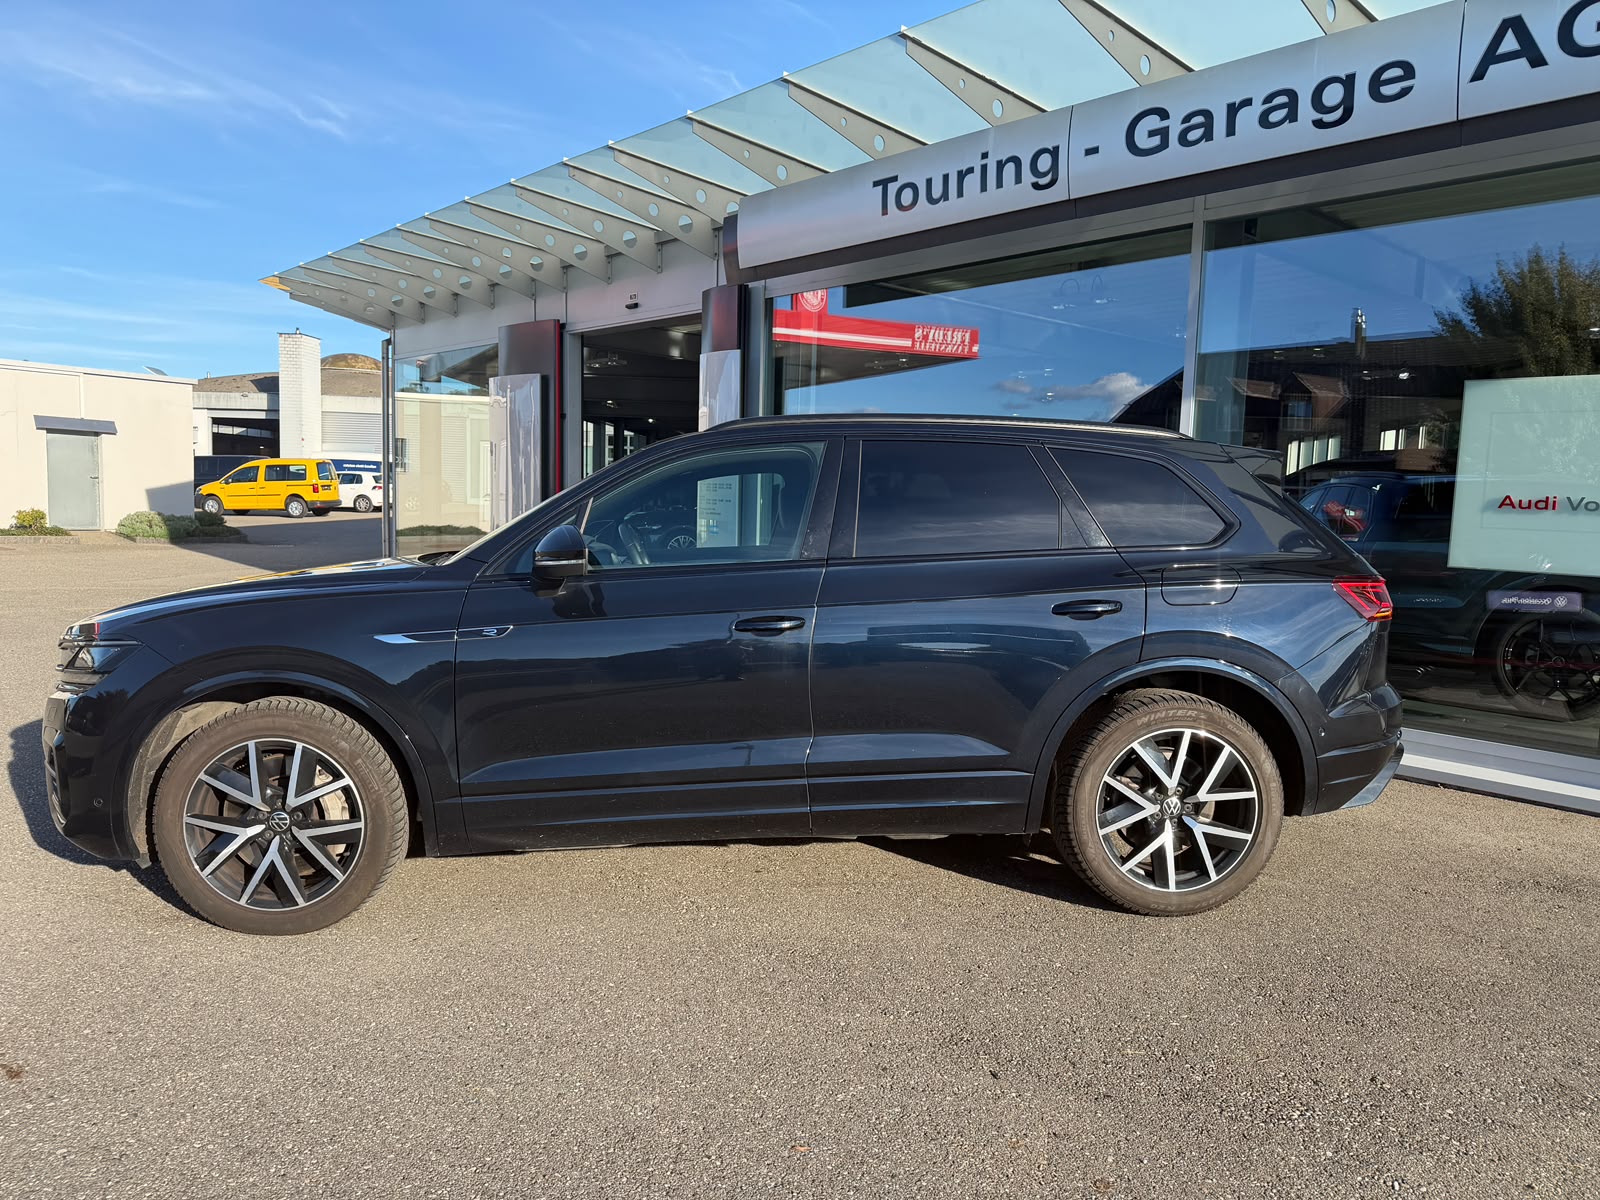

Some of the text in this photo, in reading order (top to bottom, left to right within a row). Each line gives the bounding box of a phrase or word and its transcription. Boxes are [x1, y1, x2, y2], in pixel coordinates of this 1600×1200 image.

[872, 144, 1060, 216] Touring
[1125, 59, 1416, 157] Garage
[1467, 0, 1600, 83] AG
[1498, 495, 1600, 511] Audi Vo
